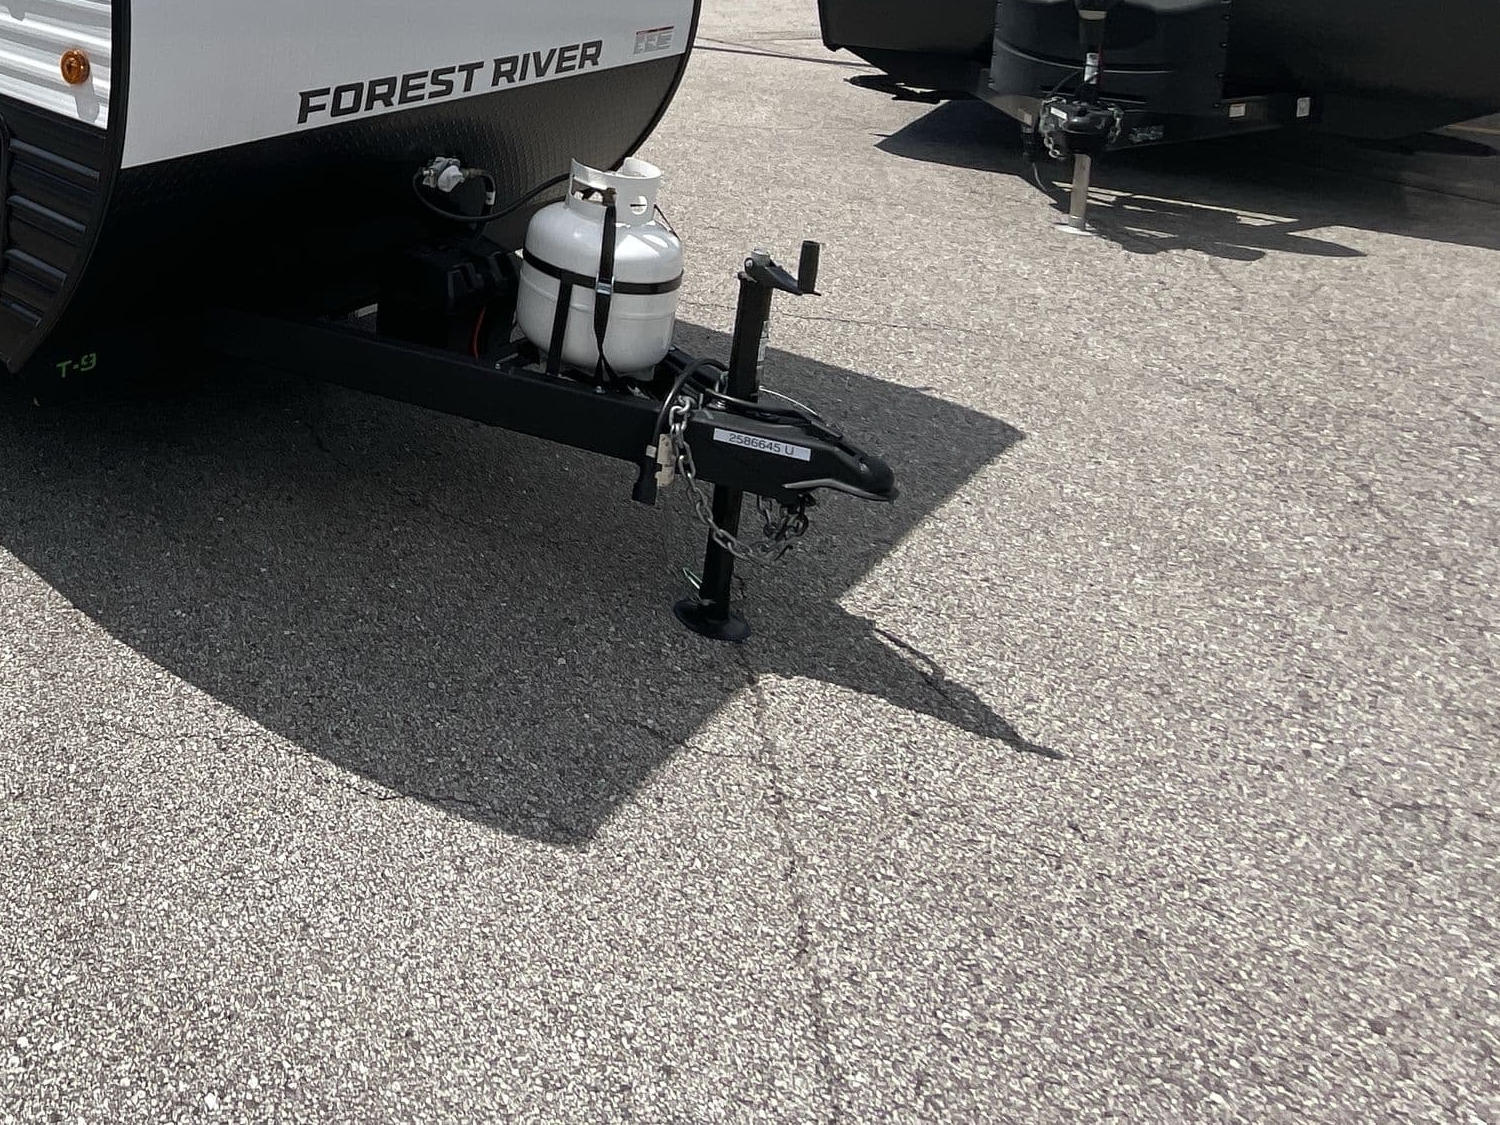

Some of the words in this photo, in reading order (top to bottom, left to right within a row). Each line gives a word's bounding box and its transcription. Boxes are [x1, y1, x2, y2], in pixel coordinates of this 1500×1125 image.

[297, 61, 484, 124] FOREST
[491, 40, 603, 87] RIVER
[728, 433, 781, 453] 2586645
[784, 444, 795, 456] U
